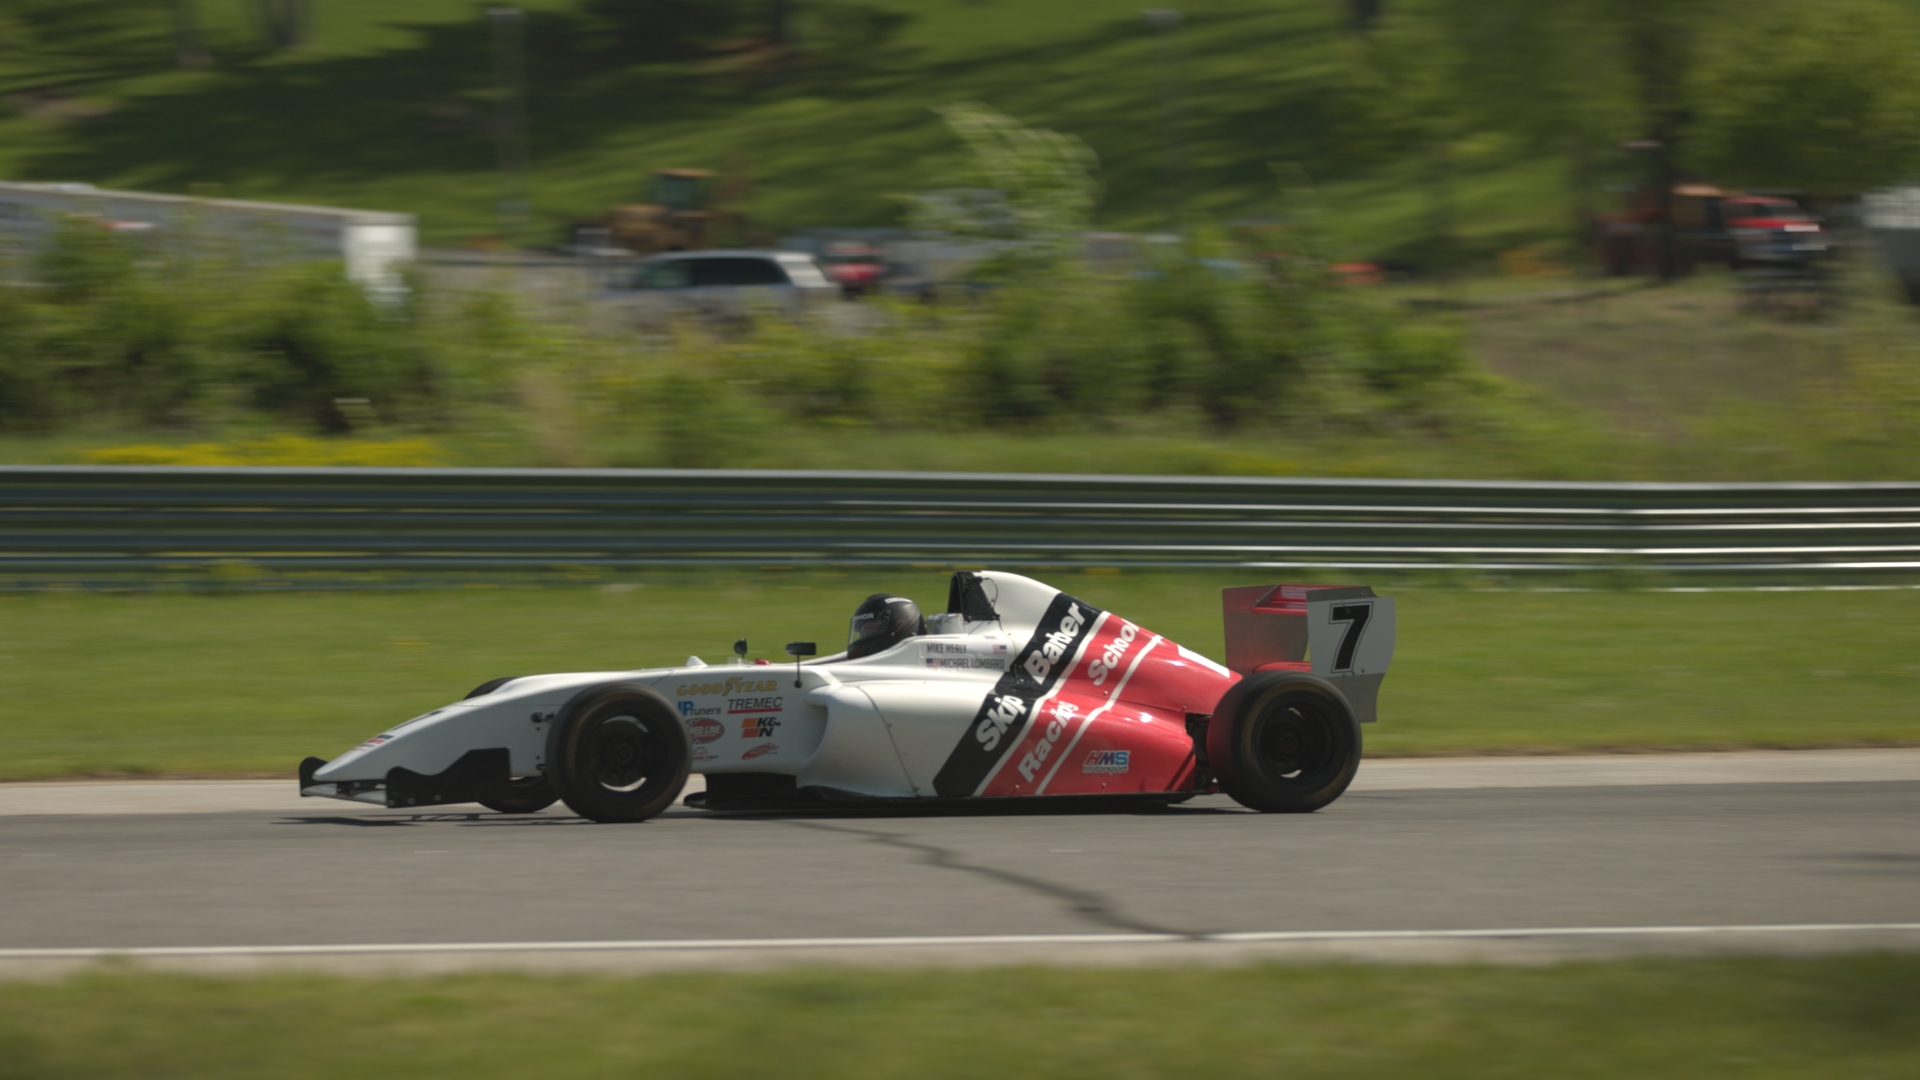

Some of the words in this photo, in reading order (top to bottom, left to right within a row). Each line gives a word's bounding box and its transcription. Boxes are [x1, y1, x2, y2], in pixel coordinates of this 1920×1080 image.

[1329, 601, 1374, 674] 7
[926, 643, 944, 654] MIKE
[945, 643, 967, 654] HEALY
[940, 658, 970, 668] MICHAEL
[971, 658, 1005, 669] LOMBARD
[975, 694, 1027, 751] Skip
[1023, 602, 1086, 685] Barber
[676, 677, 778, 696] GOODYEAR
[727, 697, 783, 710] TREMEC
[1017, 700, 1079, 783] Racing
[1087, 618, 1140, 686] School
[690, 706, 722, 716] tuners
[1083, 750, 1131, 766] HMS
[1083, 766, 1129, 775] motorsport
